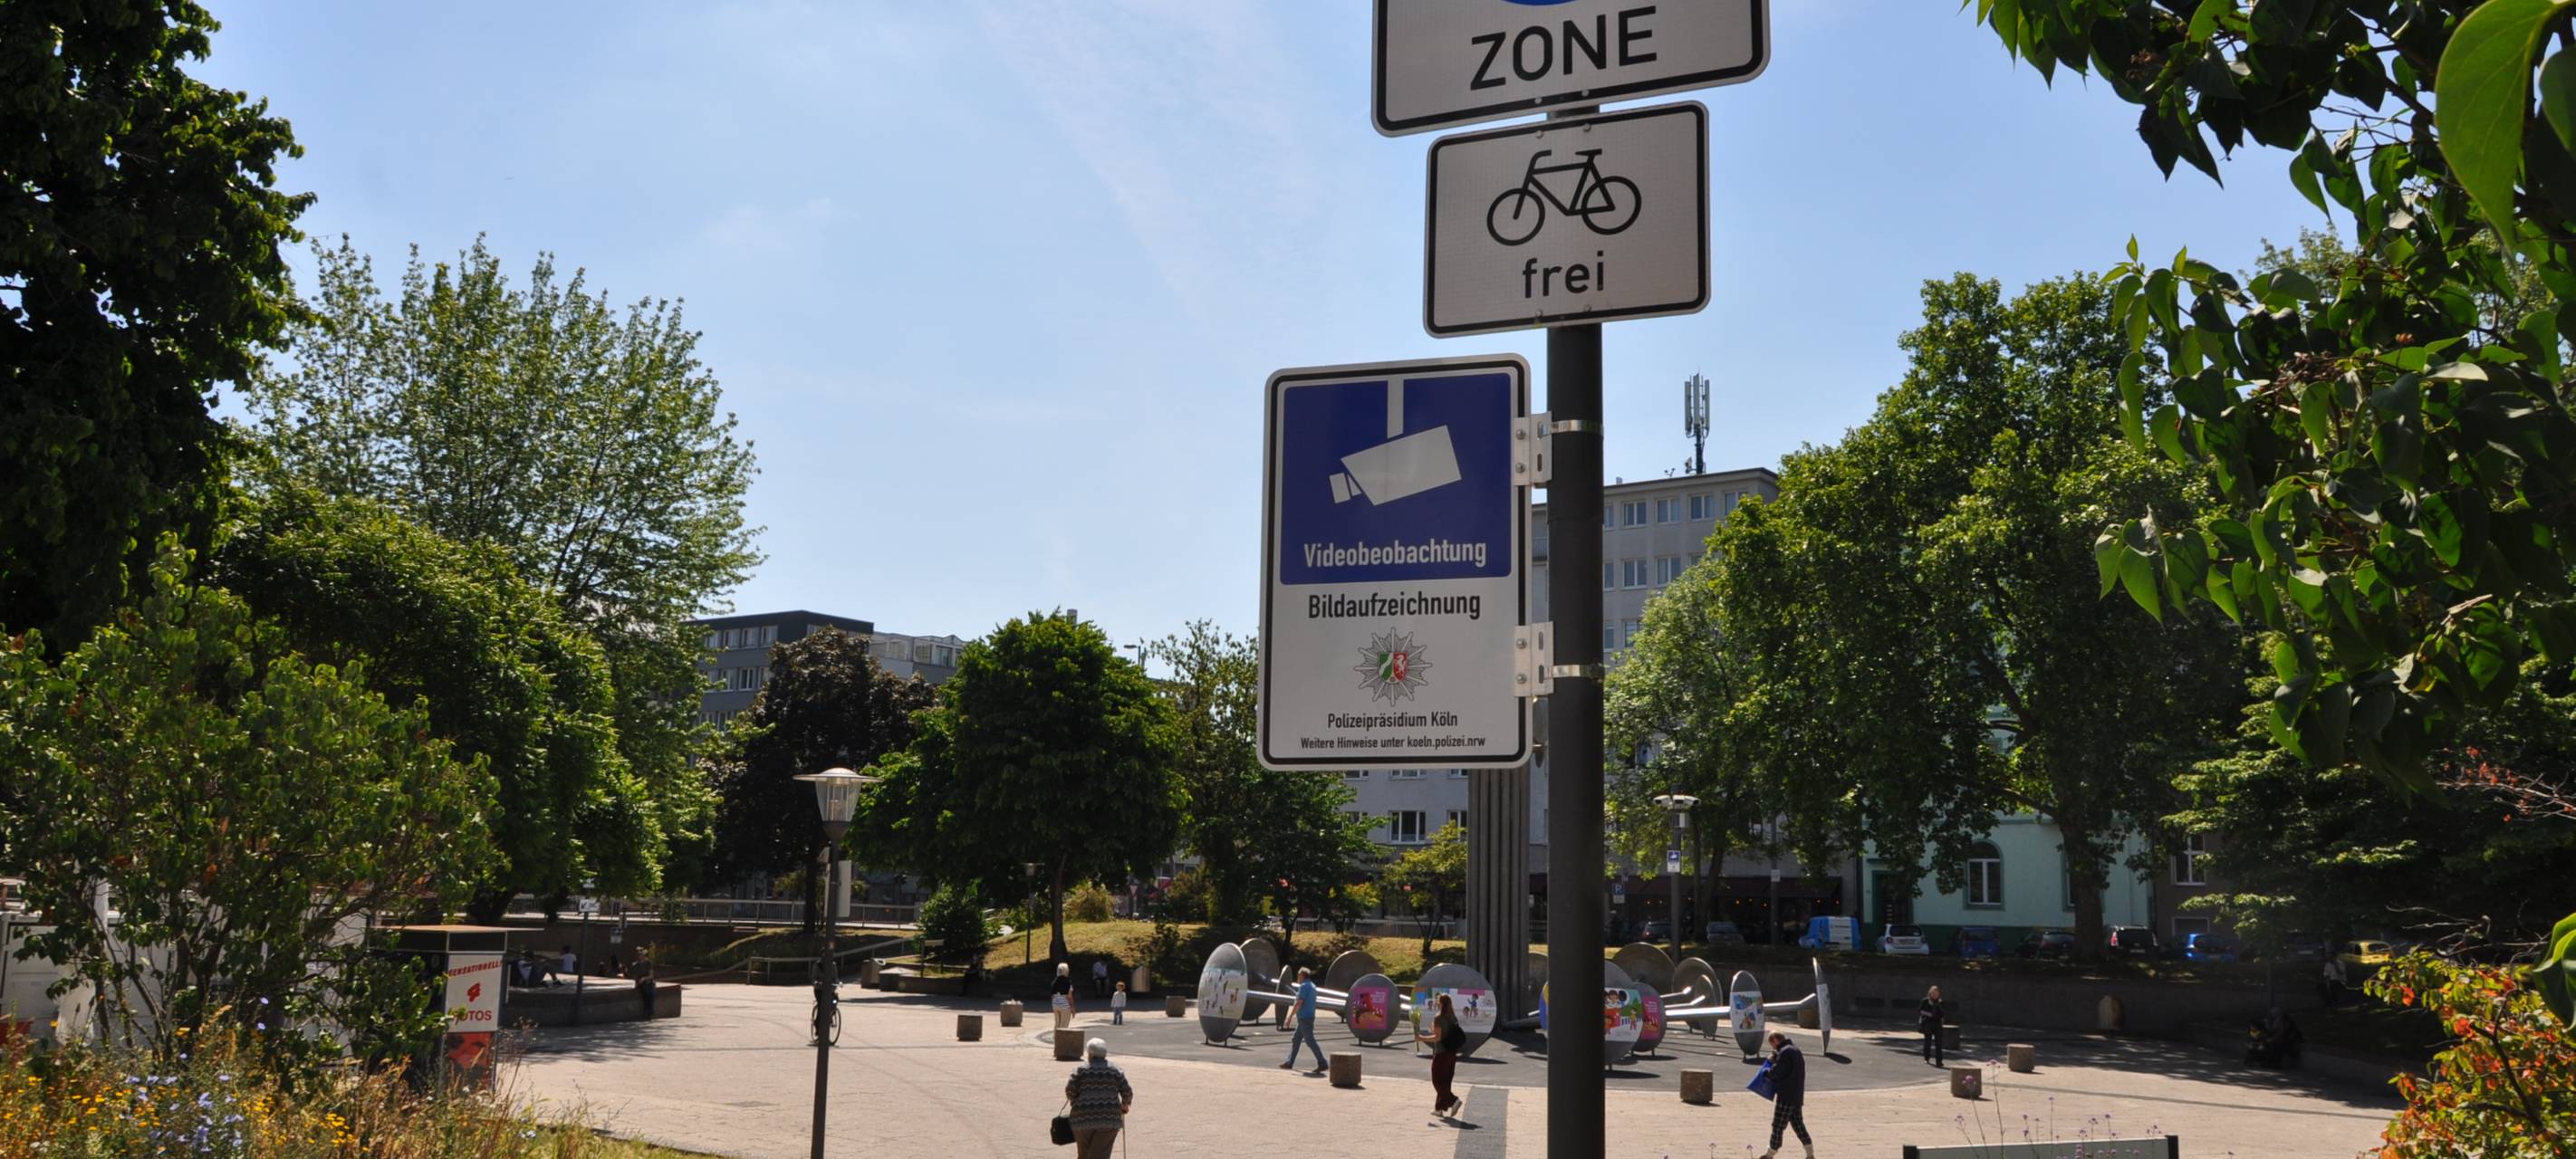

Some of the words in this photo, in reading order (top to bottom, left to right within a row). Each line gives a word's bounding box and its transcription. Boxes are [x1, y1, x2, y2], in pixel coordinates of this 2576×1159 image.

[1470, 5, 1657, 91] ZONE
[1522, 250, 1605, 299] frei
[1303, 538, 1487, 568] Videobeobachtung
[1308, 590, 1481, 620] Bildaufzeichnung
[1327, 712, 1427, 732] Polizeipräsidium
[1430, 711, 1458, 727] Köln
[1300, 736, 1335, 750] Weitere
[1337, 736, 1379, 750] Hinweise
[1380, 735, 1405, 749] unter
[1406, 734, 1486, 751] koeln.polizei.nrw
[466, 982, 482, 1002] 4
[453, 1010, 493, 1022] OTOS
